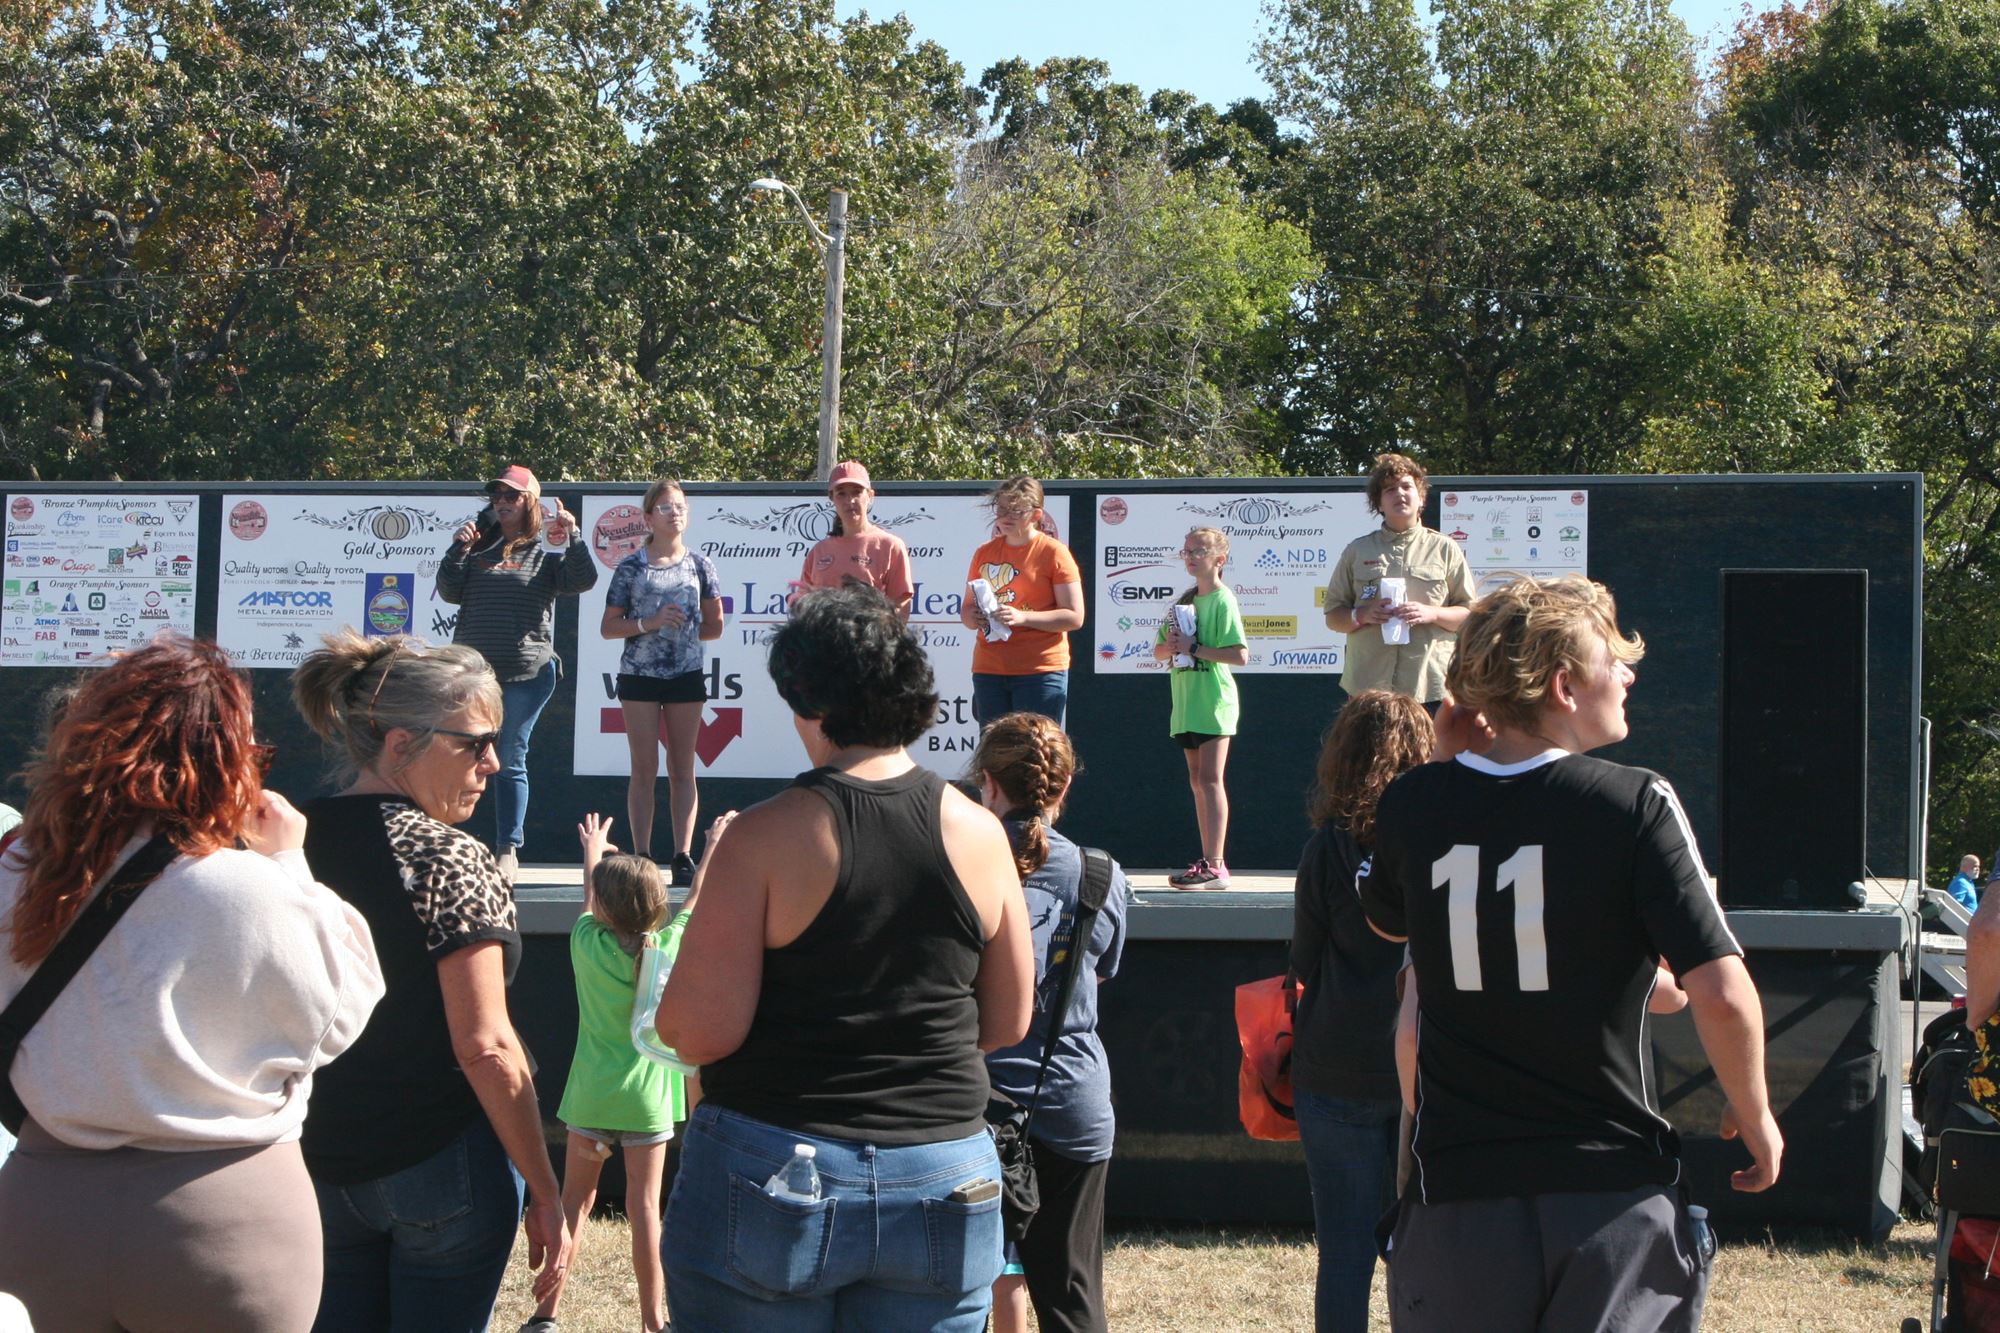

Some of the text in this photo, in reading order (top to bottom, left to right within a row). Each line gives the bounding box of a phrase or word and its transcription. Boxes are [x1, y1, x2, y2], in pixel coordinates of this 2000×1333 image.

[41, 498, 76, 508] Bronze
[77, 498, 118, 511] Pumpkin
[117, 498, 157, 511] Sponsors
[1221, 525, 1324, 540] Pumpkin Sponsors
[343, 541, 436, 560] Gold Sponsors
[701, 541, 781, 558] Platinum
[907, 546, 944, 558] nsors
[1287, 549, 1327, 563] NDB
[172, 562, 192, 570] Pizza
[224, 560, 260, 577] Quality
[262, 566, 289, 574] MOTORS
[294, 560, 331, 578] Quality
[49, 579, 78, 590] Orange
[79, 579, 116, 591] Pumpkin
[115, 579, 150, 591] Sponsors
[1122, 586, 1174, 600] SMP
[238, 590, 333, 608] MATCOR
[1134, 618, 1169, 626] SOUTH
[1265, 620, 1291, 629] Jones
[35, 631, 57, 641] FAB
[921, 630, 960, 647] You.
[1120, 640, 1150, 659] Lee's
[1268, 650, 1338, 667] SKYWARD
[928, 735, 975, 752] BAN
[1431, 843, 1549, 992] 11
